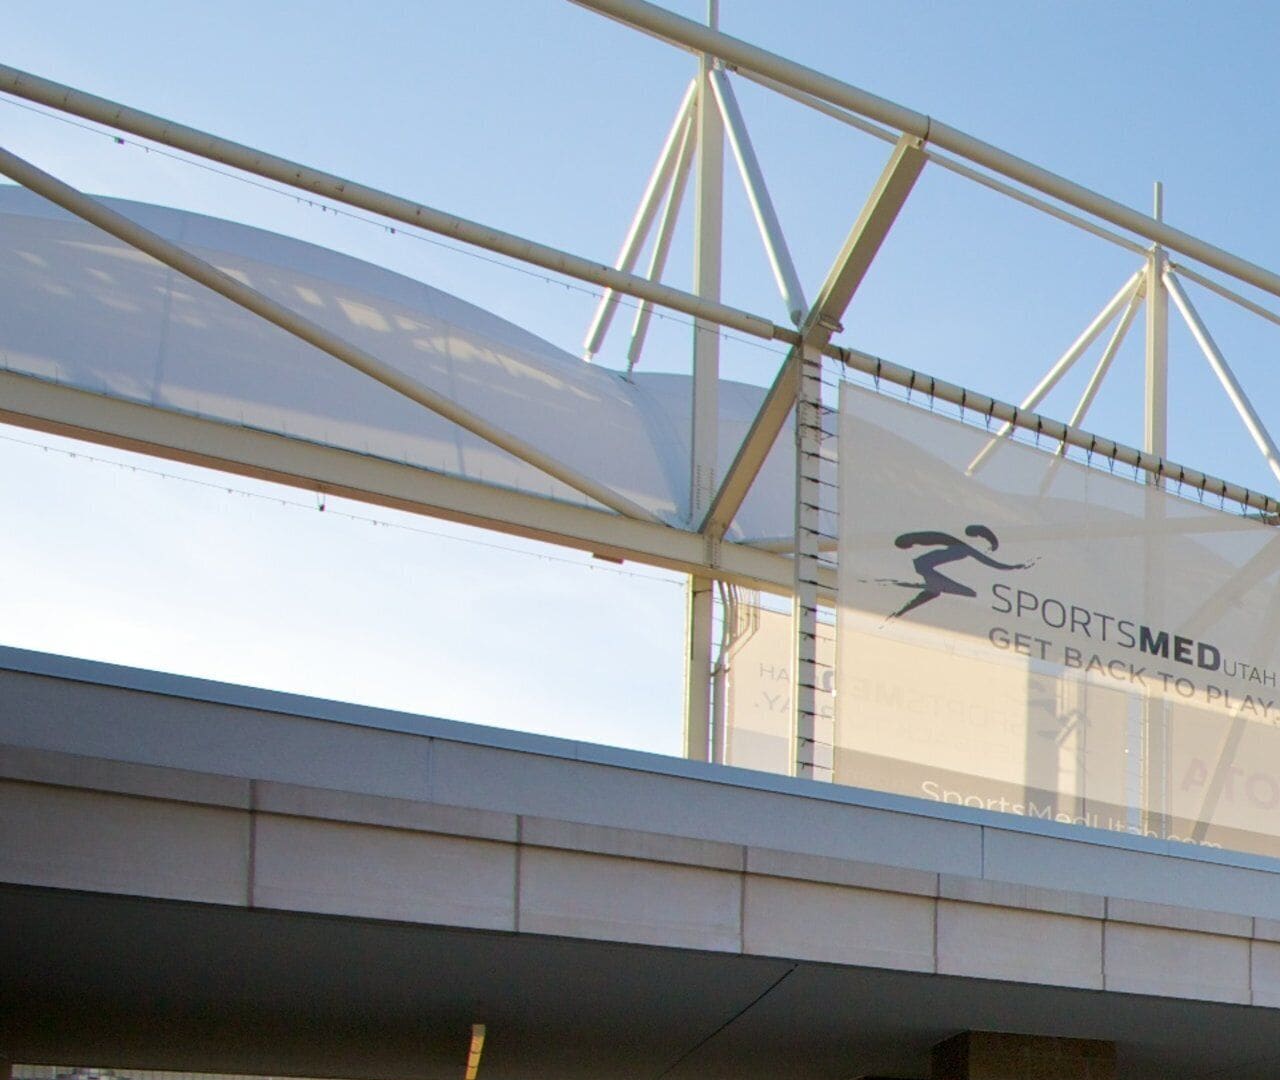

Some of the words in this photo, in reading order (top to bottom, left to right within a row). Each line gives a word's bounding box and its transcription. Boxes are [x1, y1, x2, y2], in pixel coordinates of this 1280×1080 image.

[989, 628, 1052, 661] GET
[1064, 646, 1147, 687] BACK
[1157, 671, 1196, 698] TO
